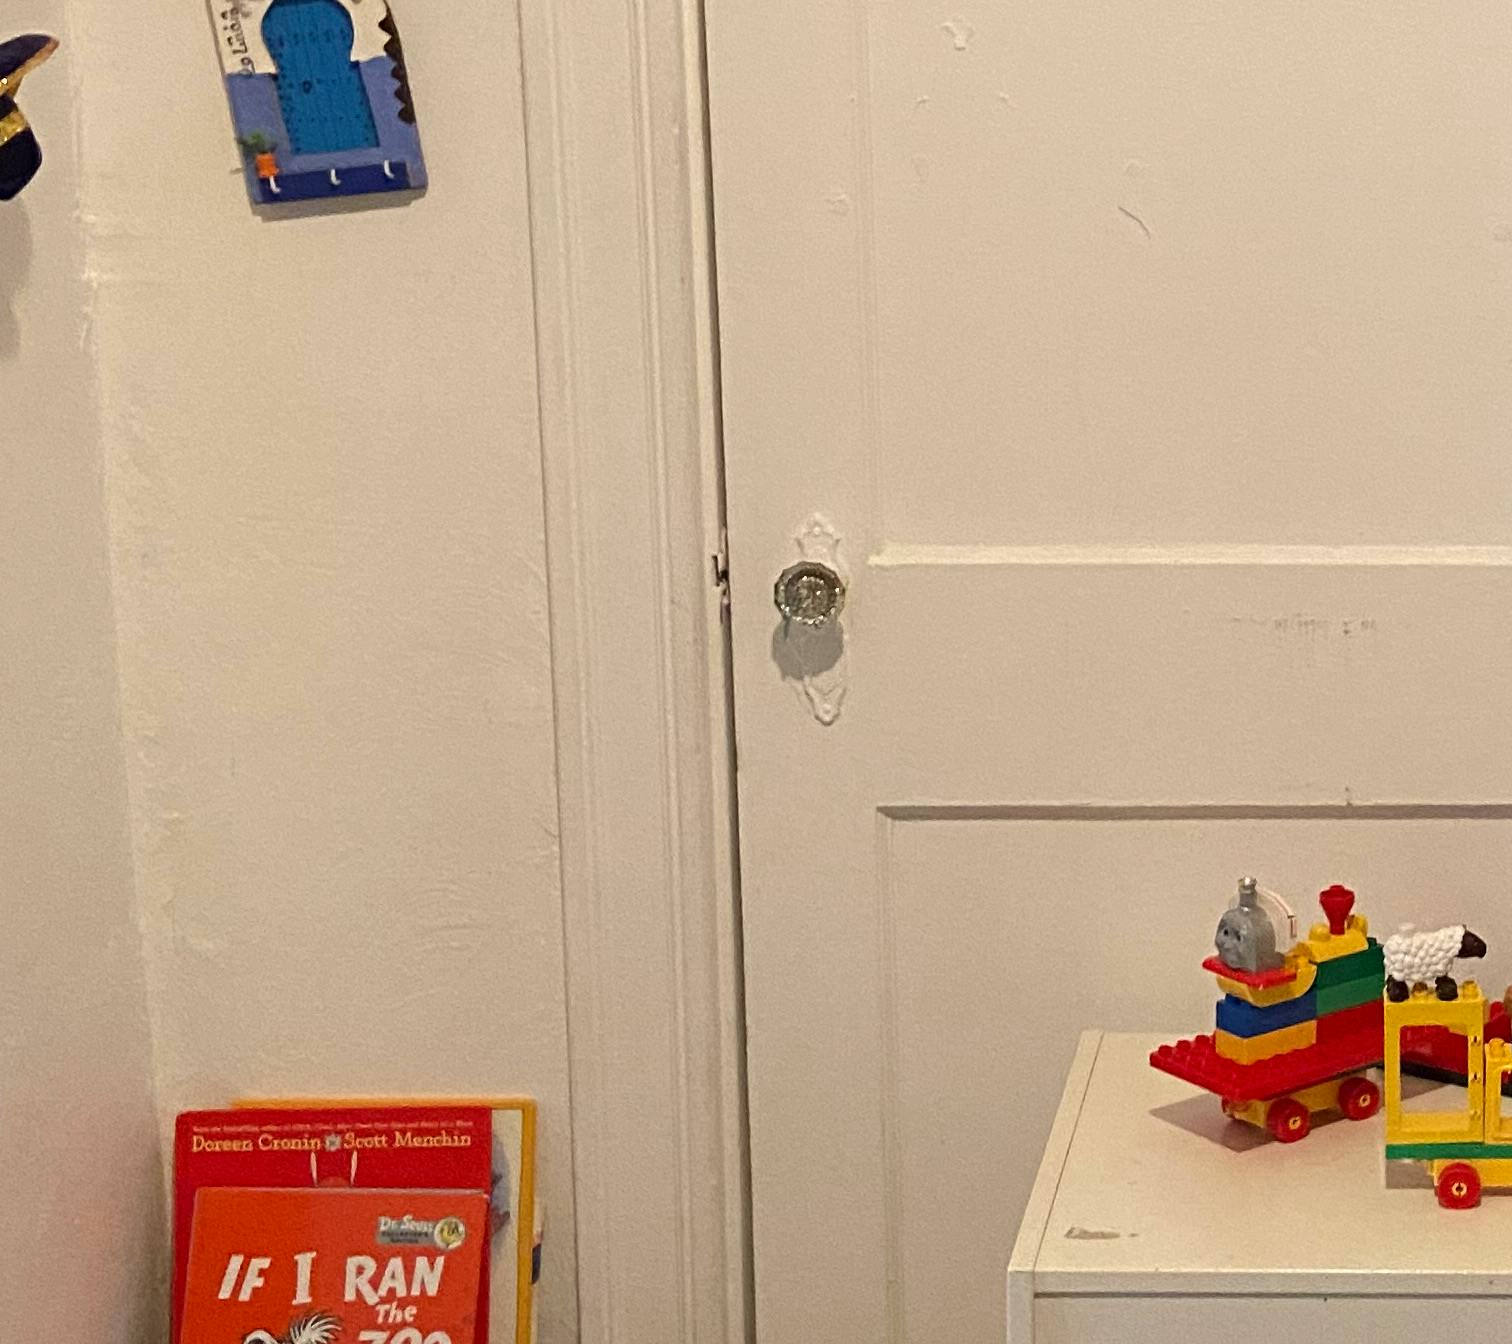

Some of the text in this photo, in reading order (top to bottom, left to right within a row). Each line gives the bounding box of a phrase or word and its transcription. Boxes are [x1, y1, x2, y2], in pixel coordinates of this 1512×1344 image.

[192, 1129, 472, 1152] Doreen Cronin Scott Menchin
[218, 1251, 445, 1306] IF I RAN
[376, 1302, 417, 1324] The
